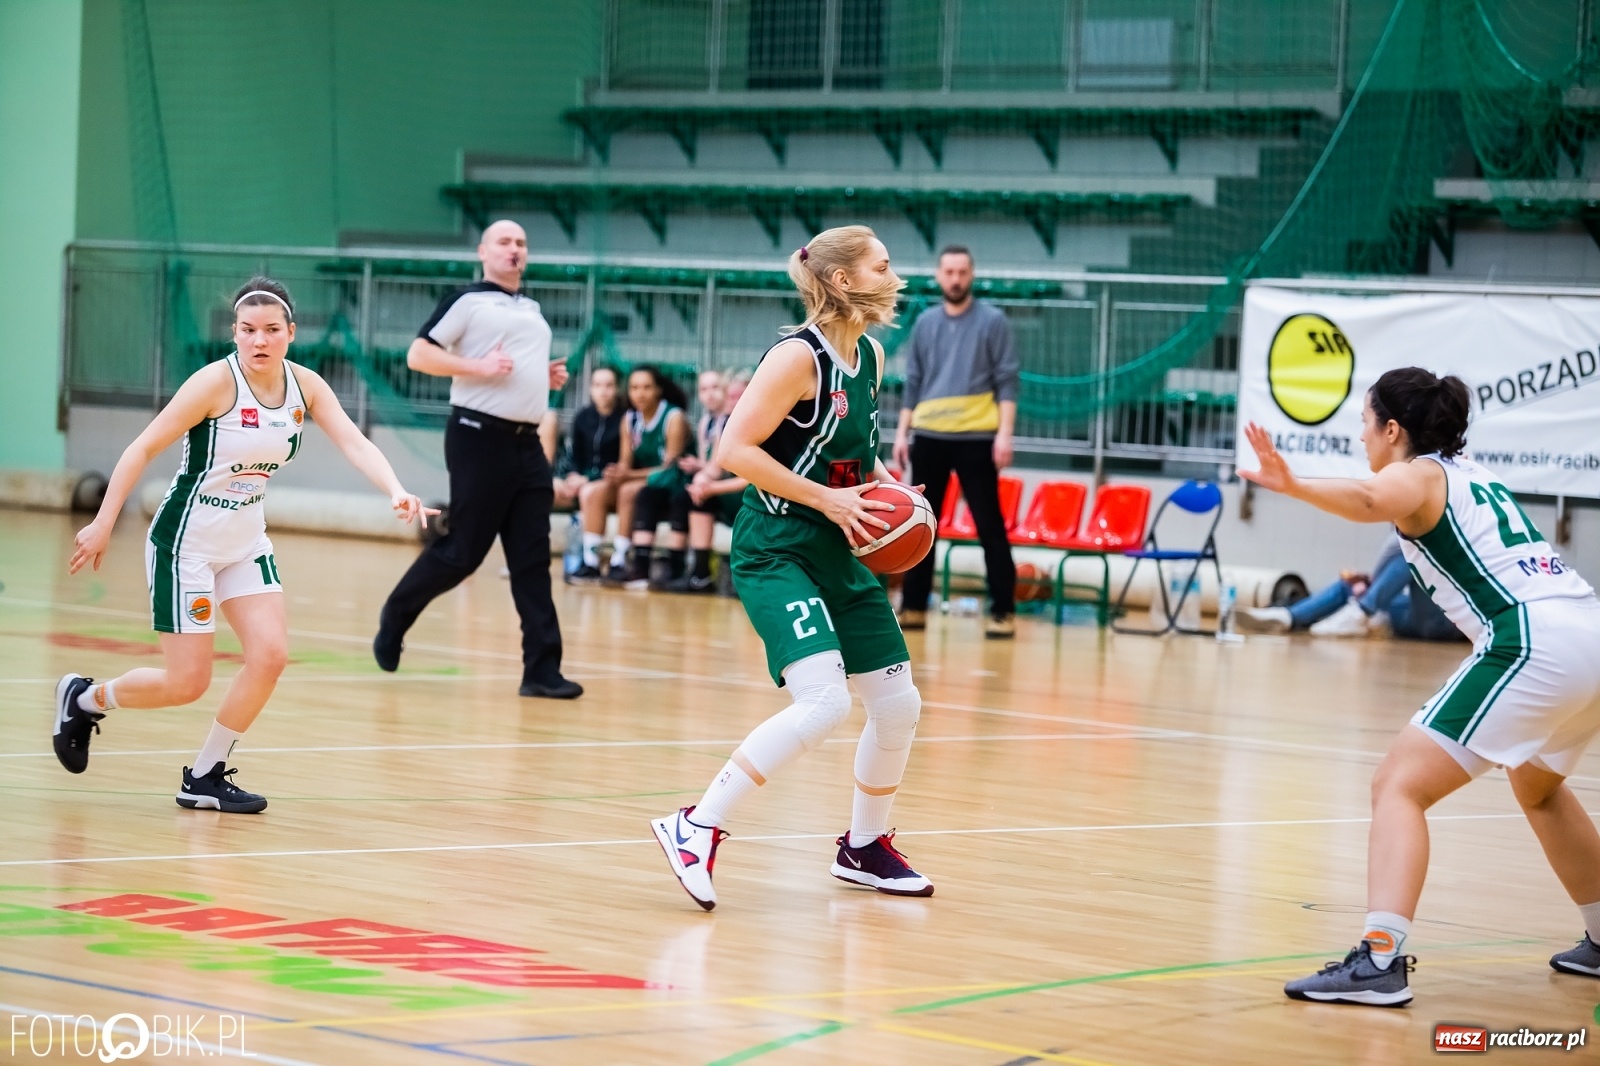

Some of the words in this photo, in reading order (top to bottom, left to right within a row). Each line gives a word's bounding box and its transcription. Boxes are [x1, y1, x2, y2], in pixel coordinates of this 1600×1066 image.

[1477, 346, 1600, 411] PORZĄD
[1268, 432, 1352, 456] ACIBÓRZ
[1470, 482, 1546, 548] 22
[786, 597, 835, 639] 27
